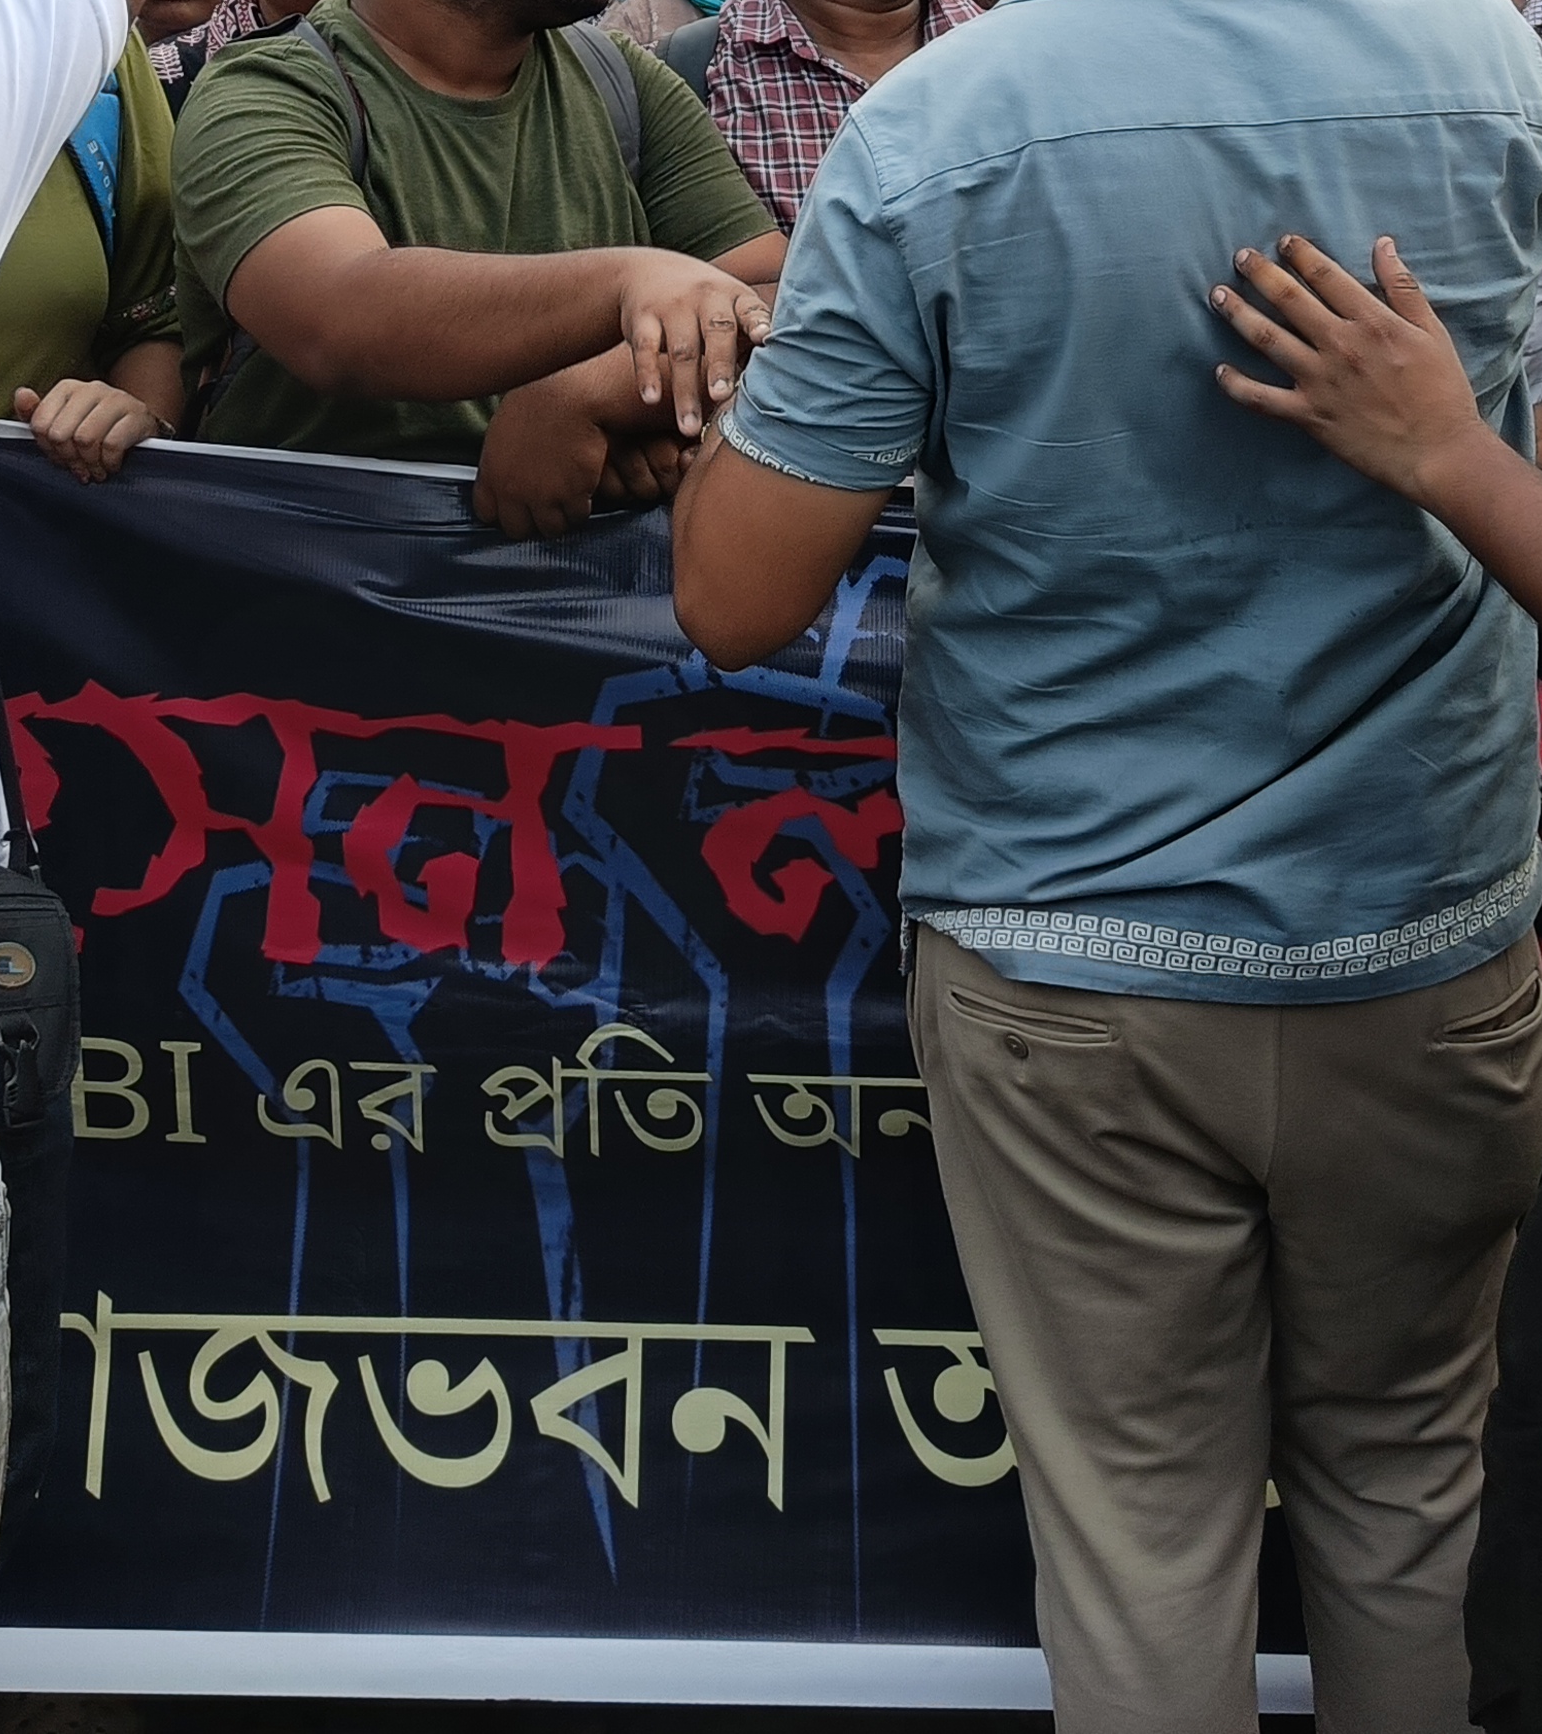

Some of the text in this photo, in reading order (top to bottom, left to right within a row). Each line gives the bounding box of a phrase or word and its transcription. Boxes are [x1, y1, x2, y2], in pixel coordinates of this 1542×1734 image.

[258, 1058, 437, 1154] এর
[480, 1023, 713, 1158] প্রতি
[59, 1289, 815, 1512] াজভবন
